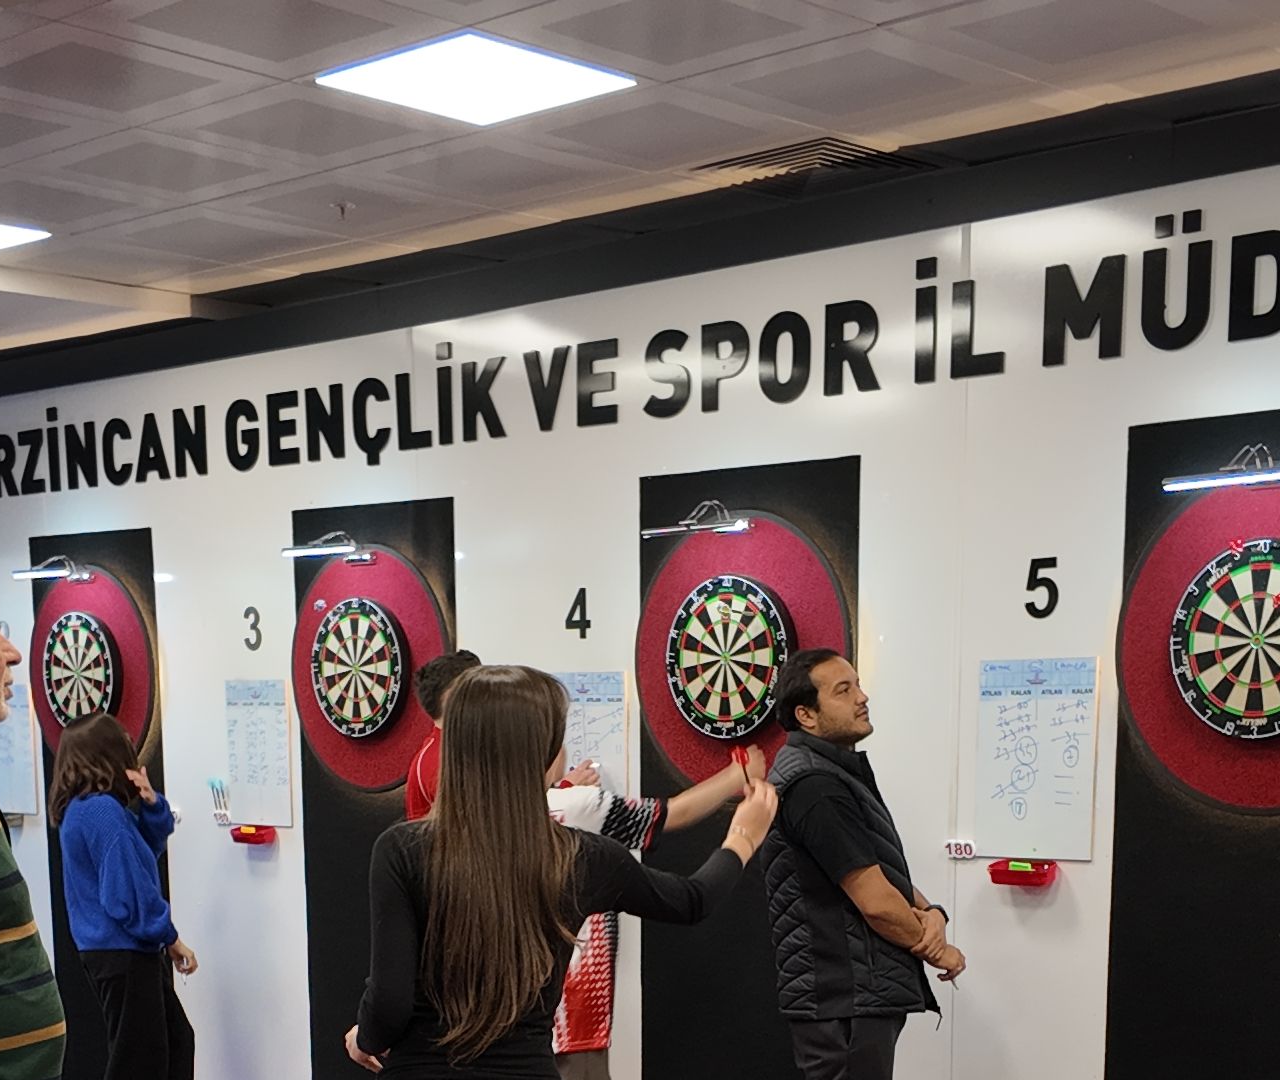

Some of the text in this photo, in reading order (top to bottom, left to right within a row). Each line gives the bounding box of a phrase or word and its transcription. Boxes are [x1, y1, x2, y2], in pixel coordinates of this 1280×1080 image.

[225, 342, 508, 466] GENÇLİK
[523, 338, 619, 432] VE
[643, 300, 882, 419] SPOR
[914, 256, 1006, 385] İL
[1025, 556, 1059, 619] 5
[244, 606, 262, 651] 3
[565, 588, 591, 639] 4
[945, 843, 973, 856] 180
